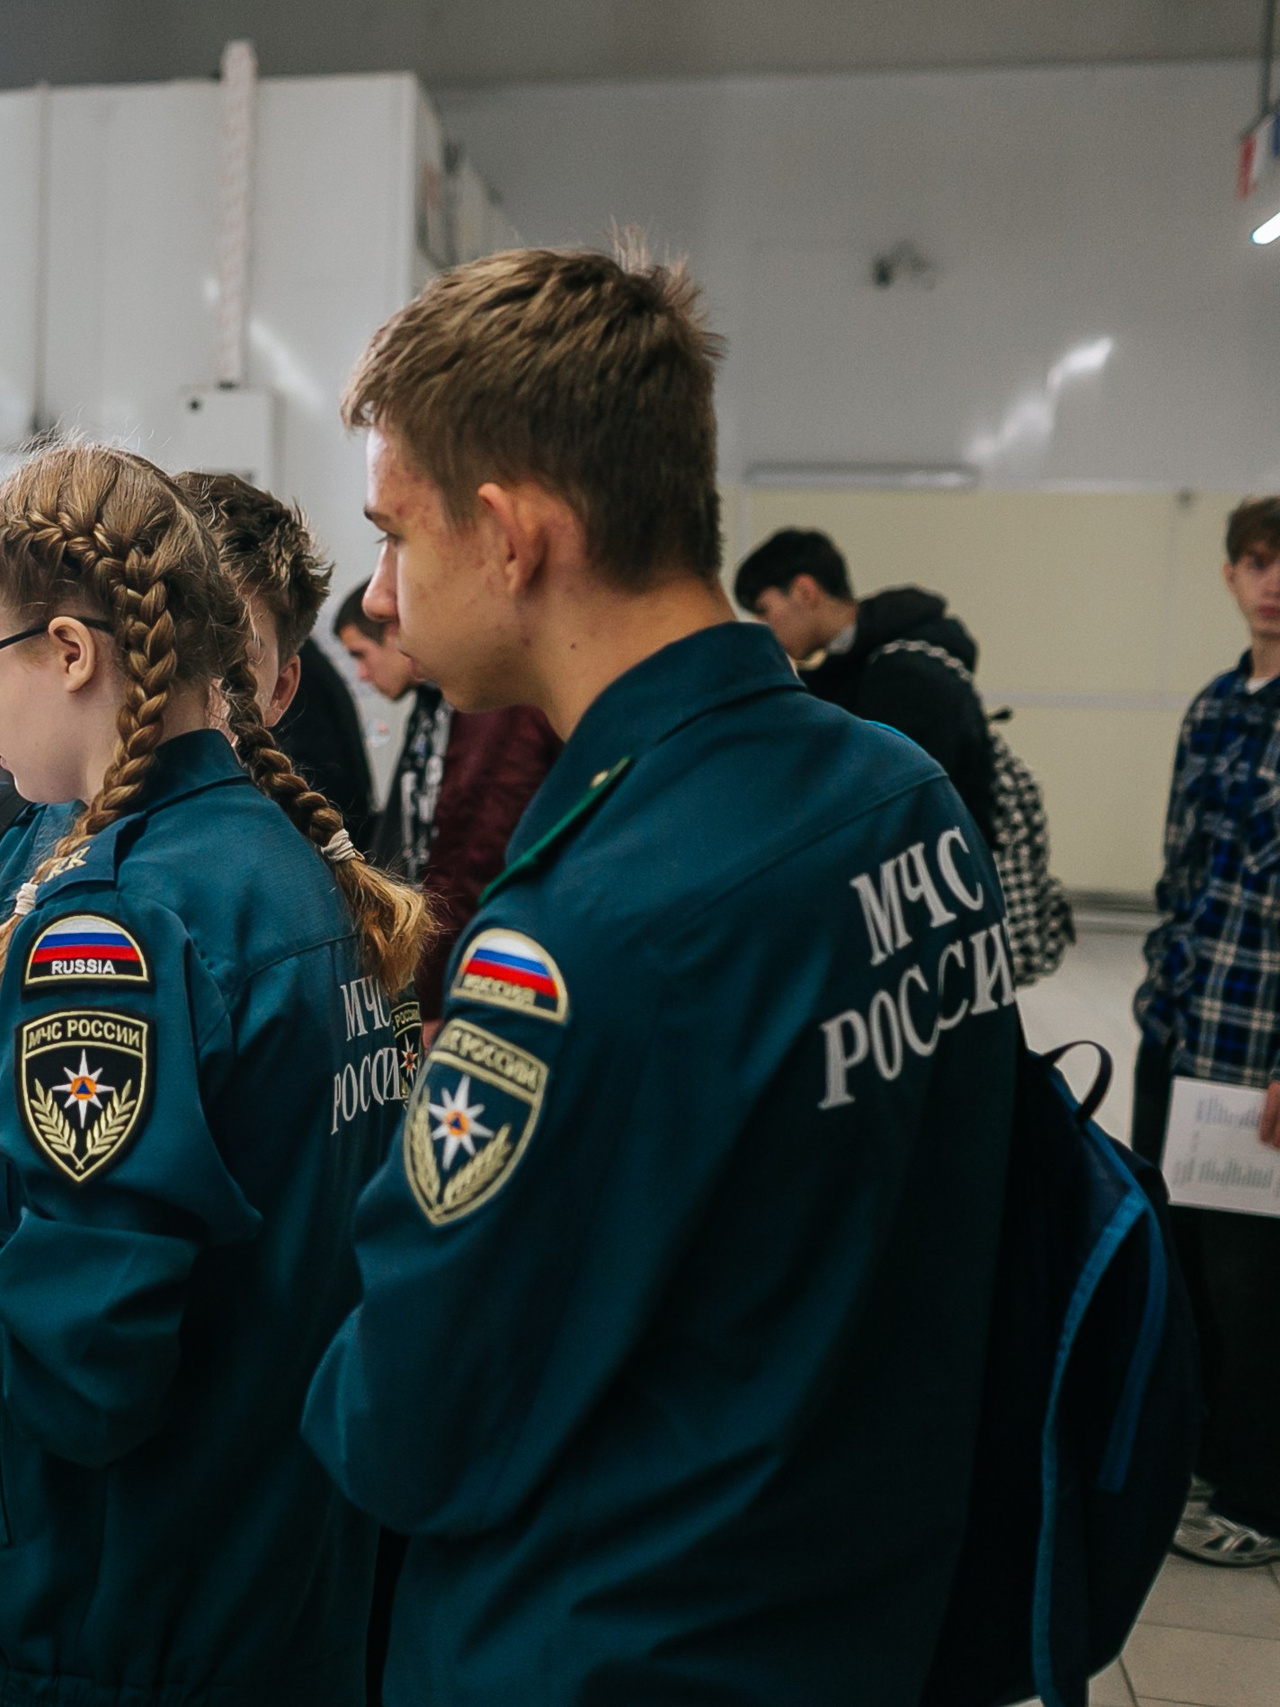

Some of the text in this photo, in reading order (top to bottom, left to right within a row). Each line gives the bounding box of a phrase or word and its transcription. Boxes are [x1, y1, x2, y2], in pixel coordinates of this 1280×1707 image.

[849, 826, 983, 966] МЧС
[51, 959, 116, 976] RUSSIA
[27, 1018, 141, 1049] МЧС РОССИИ
[817, 918, 1017, 1110] РОССИ
[330, 1047, 403, 1136] РОССИ
